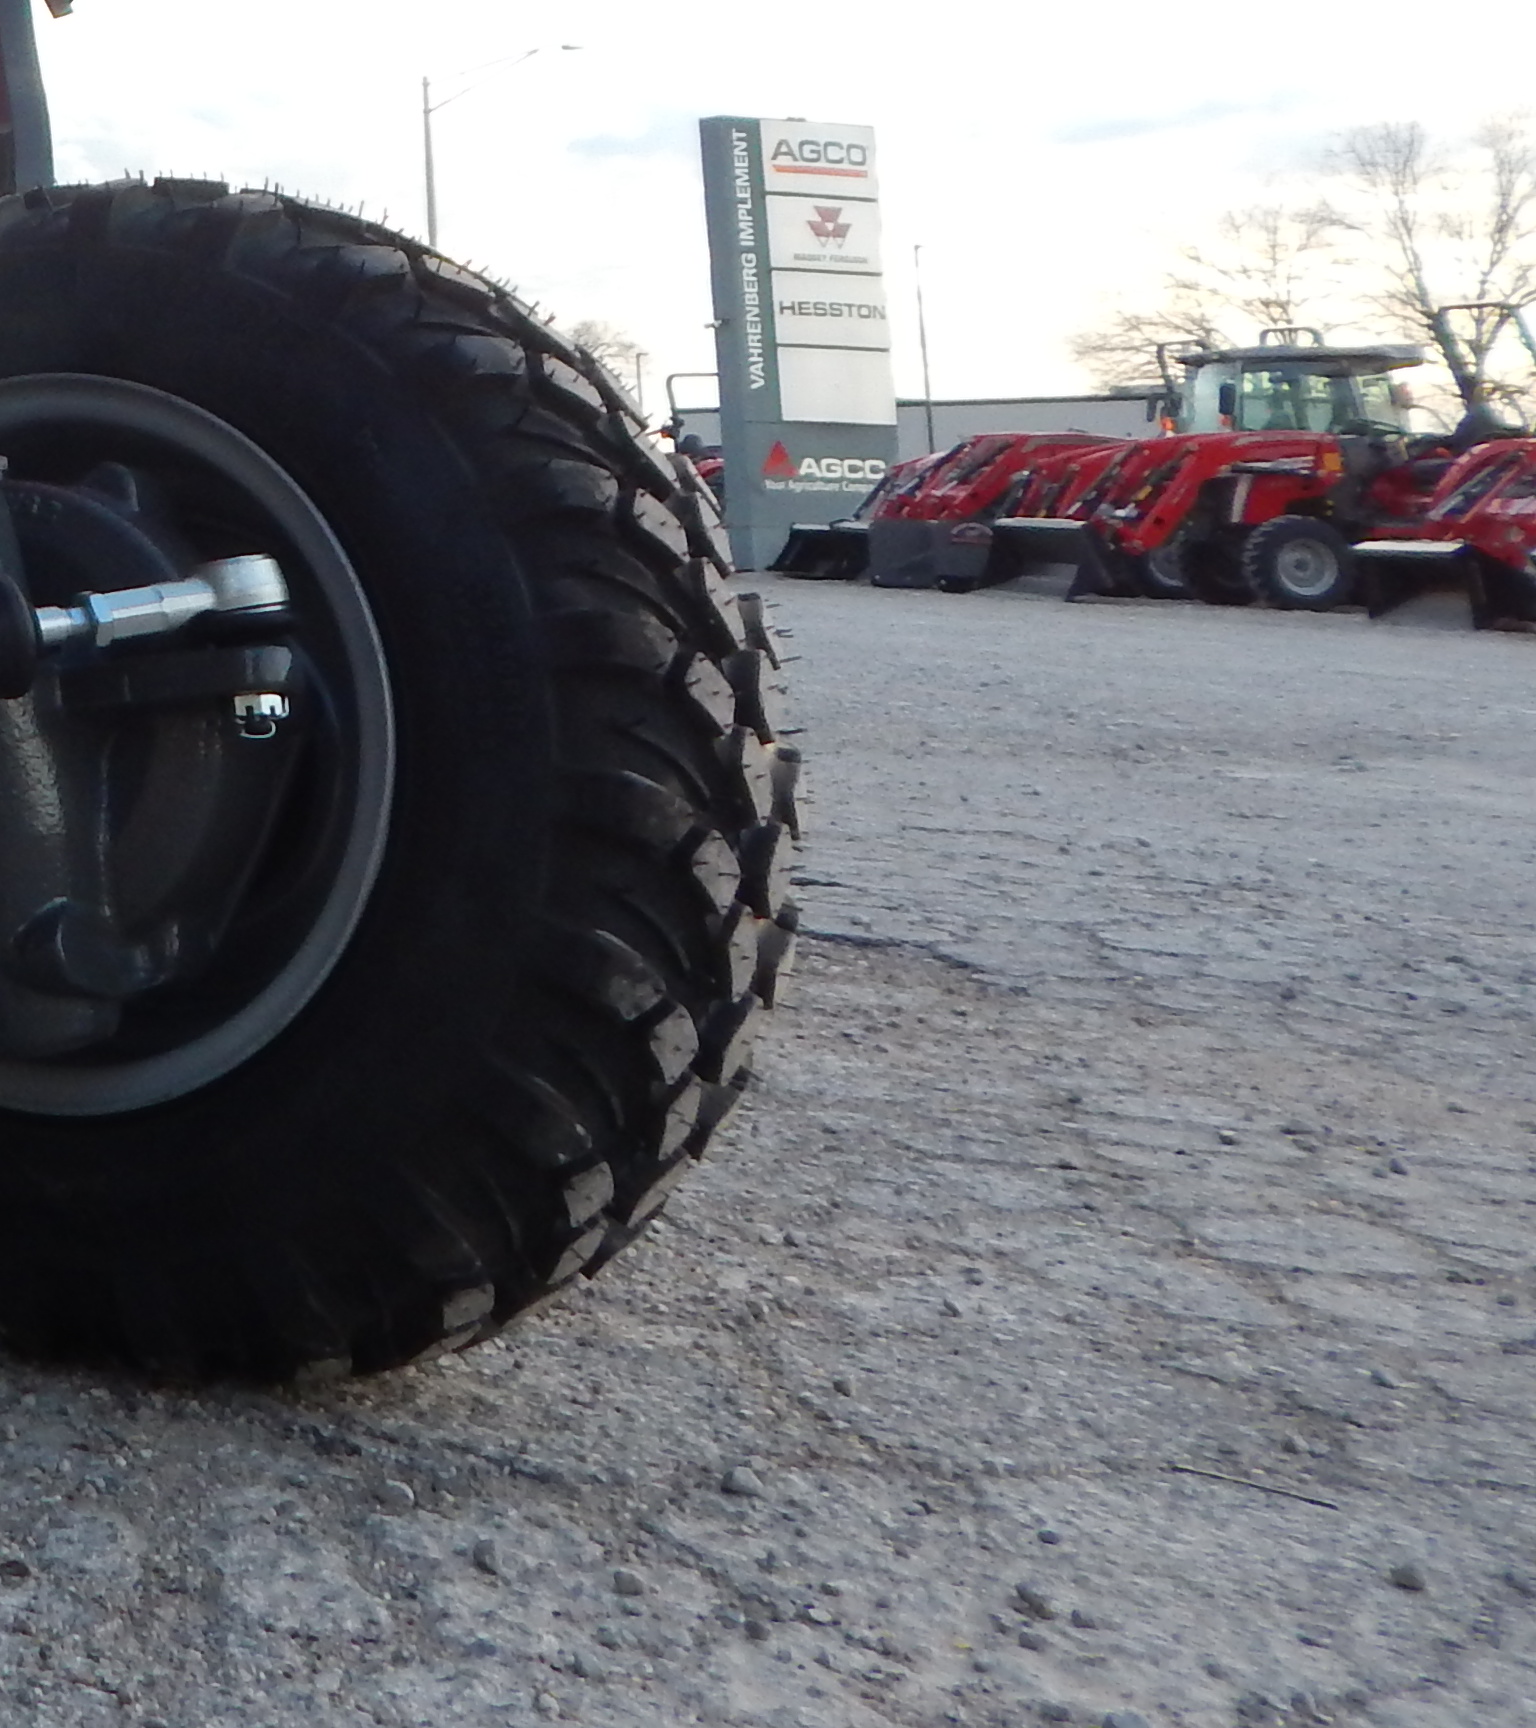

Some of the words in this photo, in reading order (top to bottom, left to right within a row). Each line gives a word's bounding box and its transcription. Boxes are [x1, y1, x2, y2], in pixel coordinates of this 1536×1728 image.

[732, 127, 755, 247] IMPLEMENT
[770, 139, 867, 166] AGCO
[741, 252, 765, 390] VAHRENBERG
[779, 300, 887, 320] HESSTON
